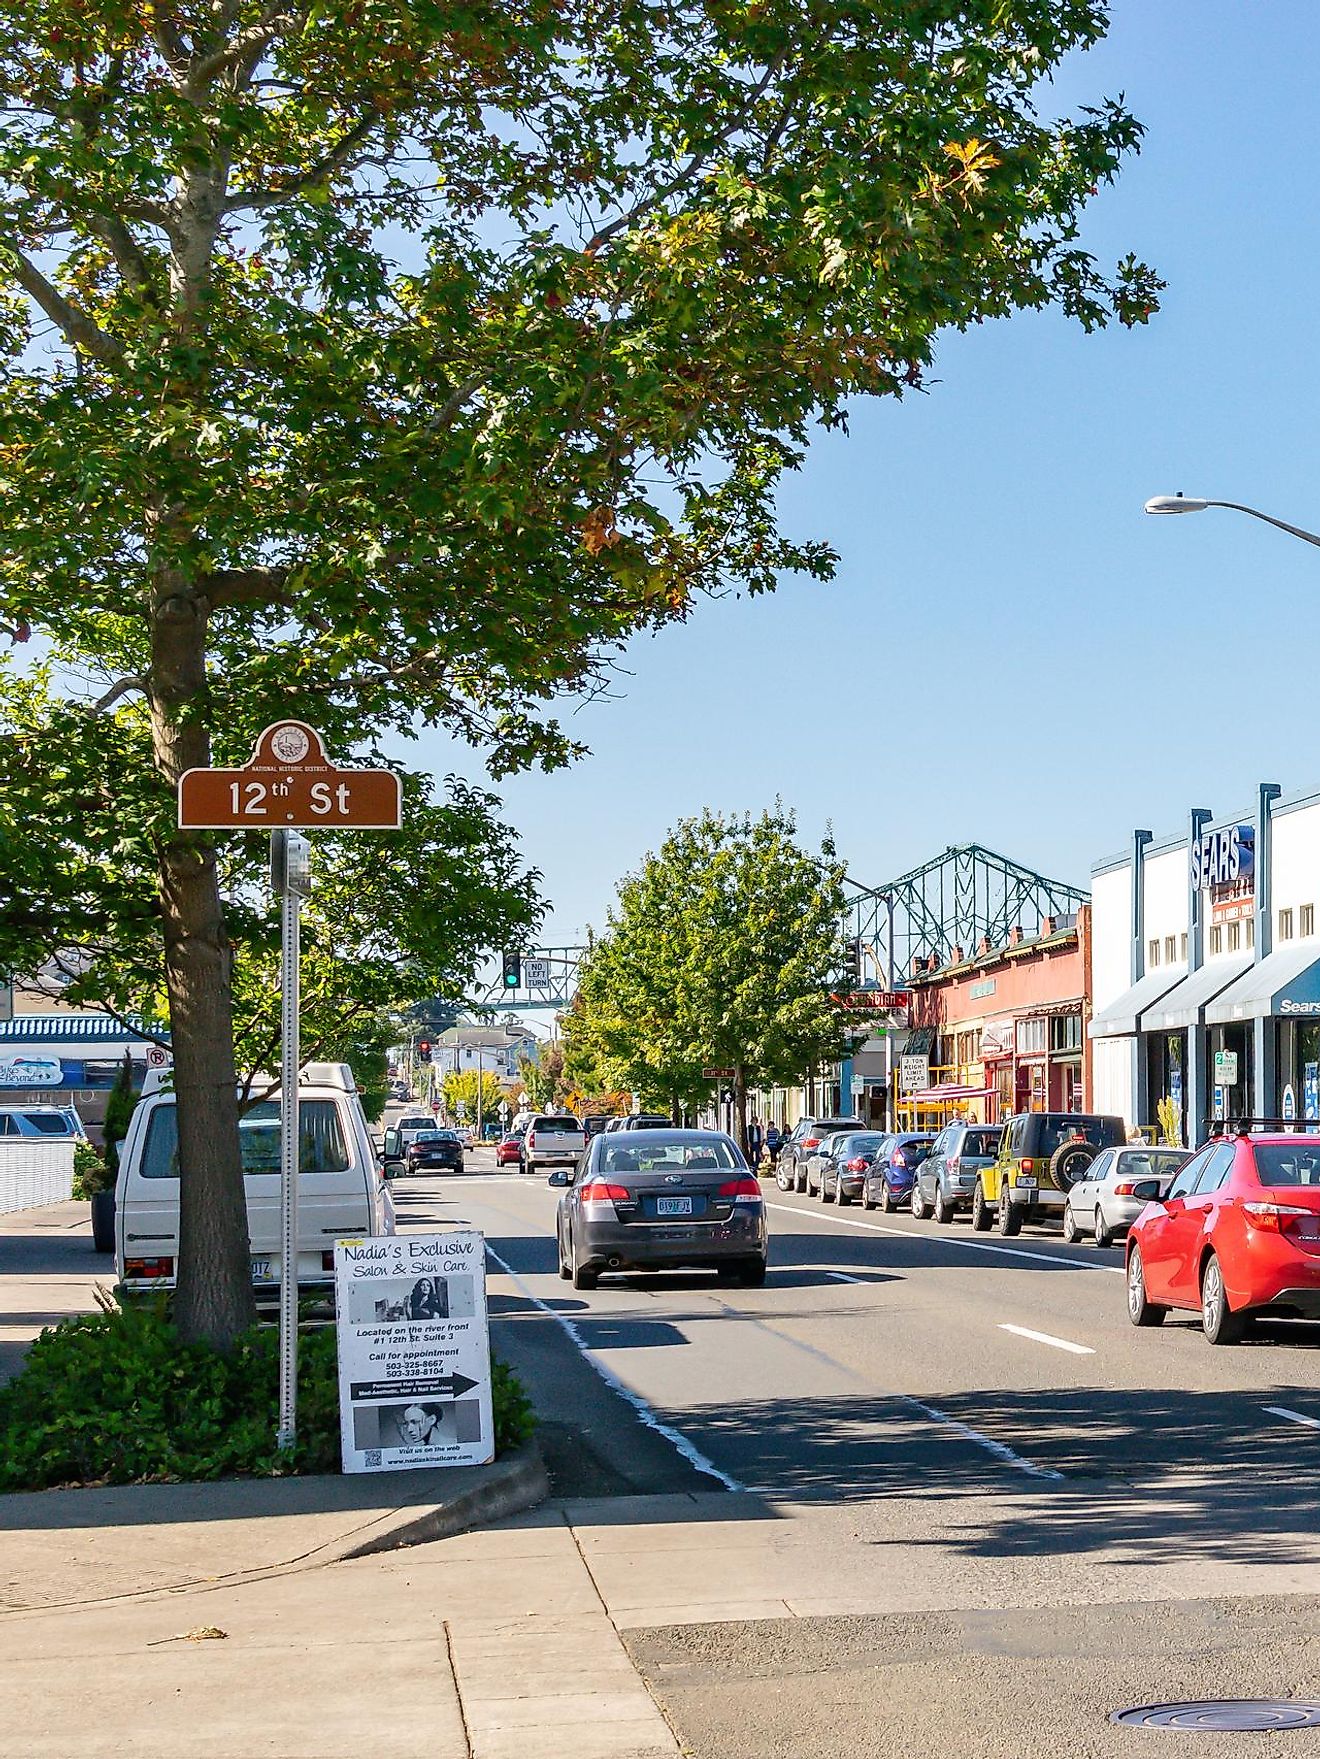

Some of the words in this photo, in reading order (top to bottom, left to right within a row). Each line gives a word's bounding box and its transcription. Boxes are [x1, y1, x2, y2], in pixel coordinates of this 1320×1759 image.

[230, 782, 289, 814] 12th
[309, 782, 350, 815] St
[1191, 825, 1240, 892] SEARS
[345, 1244, 402, 1260] Nadia's
[409, 1240, 474, 1258] Exclusive
[353, 1265, 388, 1277] Salon
[392, 1263, 407, 1275] &
[411, 1261, 438, 1274] Skin
[356, 1327, 392, 1337] Located
[408, 1326, 422, 1334] the
[425, 1325, 445, 1333] river
[447, 1323, 469, 1331] front
[388, 1335, 407, 1343] 12th
[423, 1333, 446, 1342] Suite
[369, 1353, 386, 1361] Call
[388, 1352, 401, 1360] for
[403, 1348, 459, 1360] appointment
